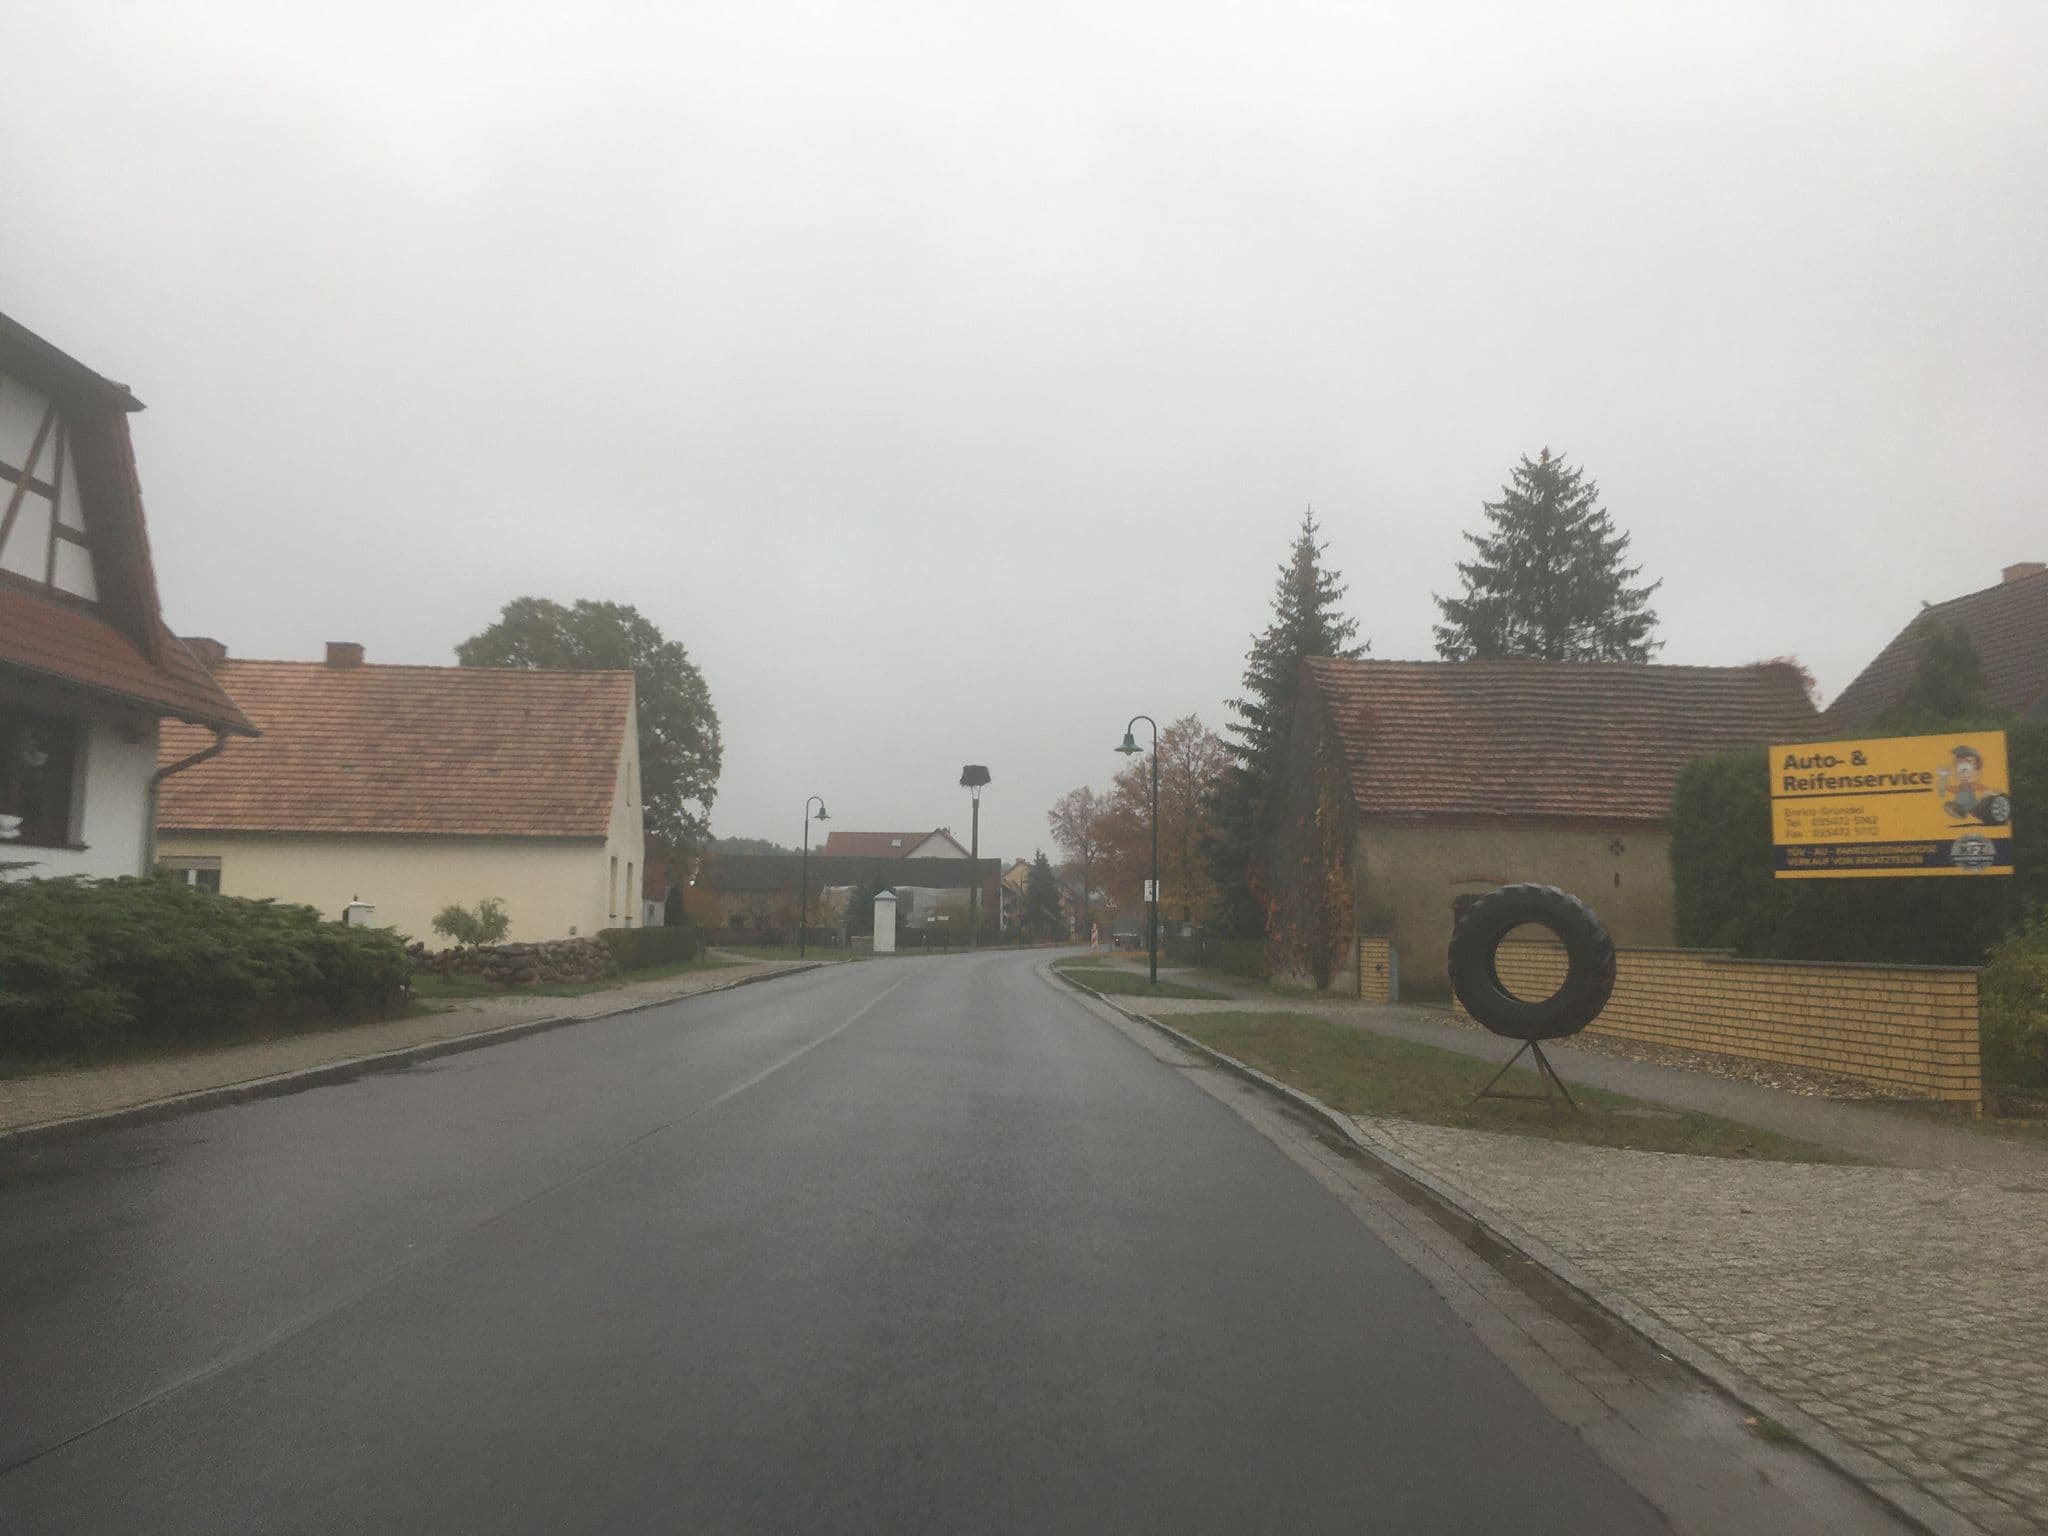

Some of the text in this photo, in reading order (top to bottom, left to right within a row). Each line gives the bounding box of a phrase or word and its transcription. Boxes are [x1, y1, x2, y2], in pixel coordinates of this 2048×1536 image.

[1783, 750, 1868, 770] Auto- &
[1783, 768, 1933, 791] Reifenservice
